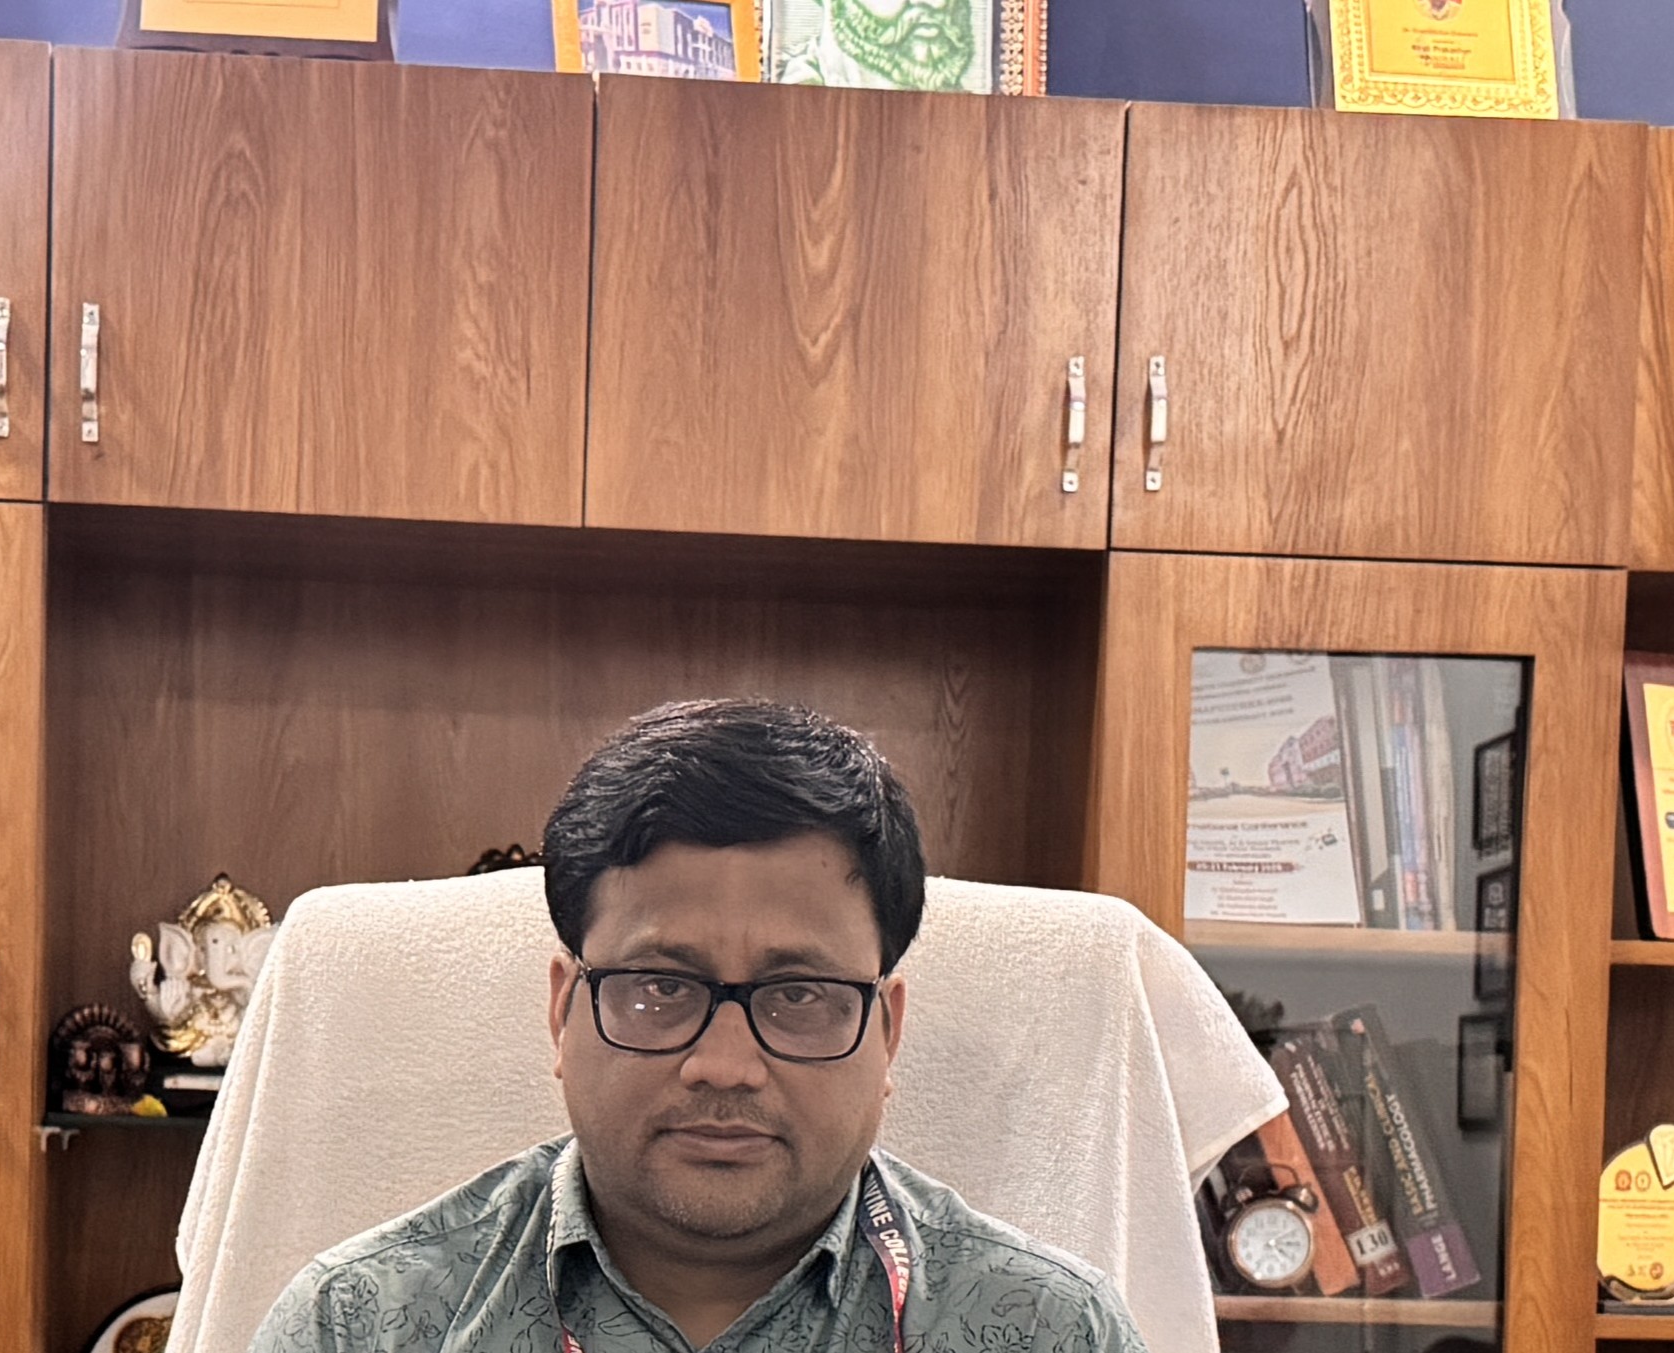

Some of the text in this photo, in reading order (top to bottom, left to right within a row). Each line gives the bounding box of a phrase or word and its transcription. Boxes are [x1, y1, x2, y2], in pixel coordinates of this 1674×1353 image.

[1385, 1093, 1438, 1211] PHARMACOLOGY
[1388, 1137, 1409, 1172] AND
[864, 1176, 892, 1227] IVINE
[1401, 1171, 1423, 1216] BASIC
[1431, 1234, 1457, 1281] LANGE
